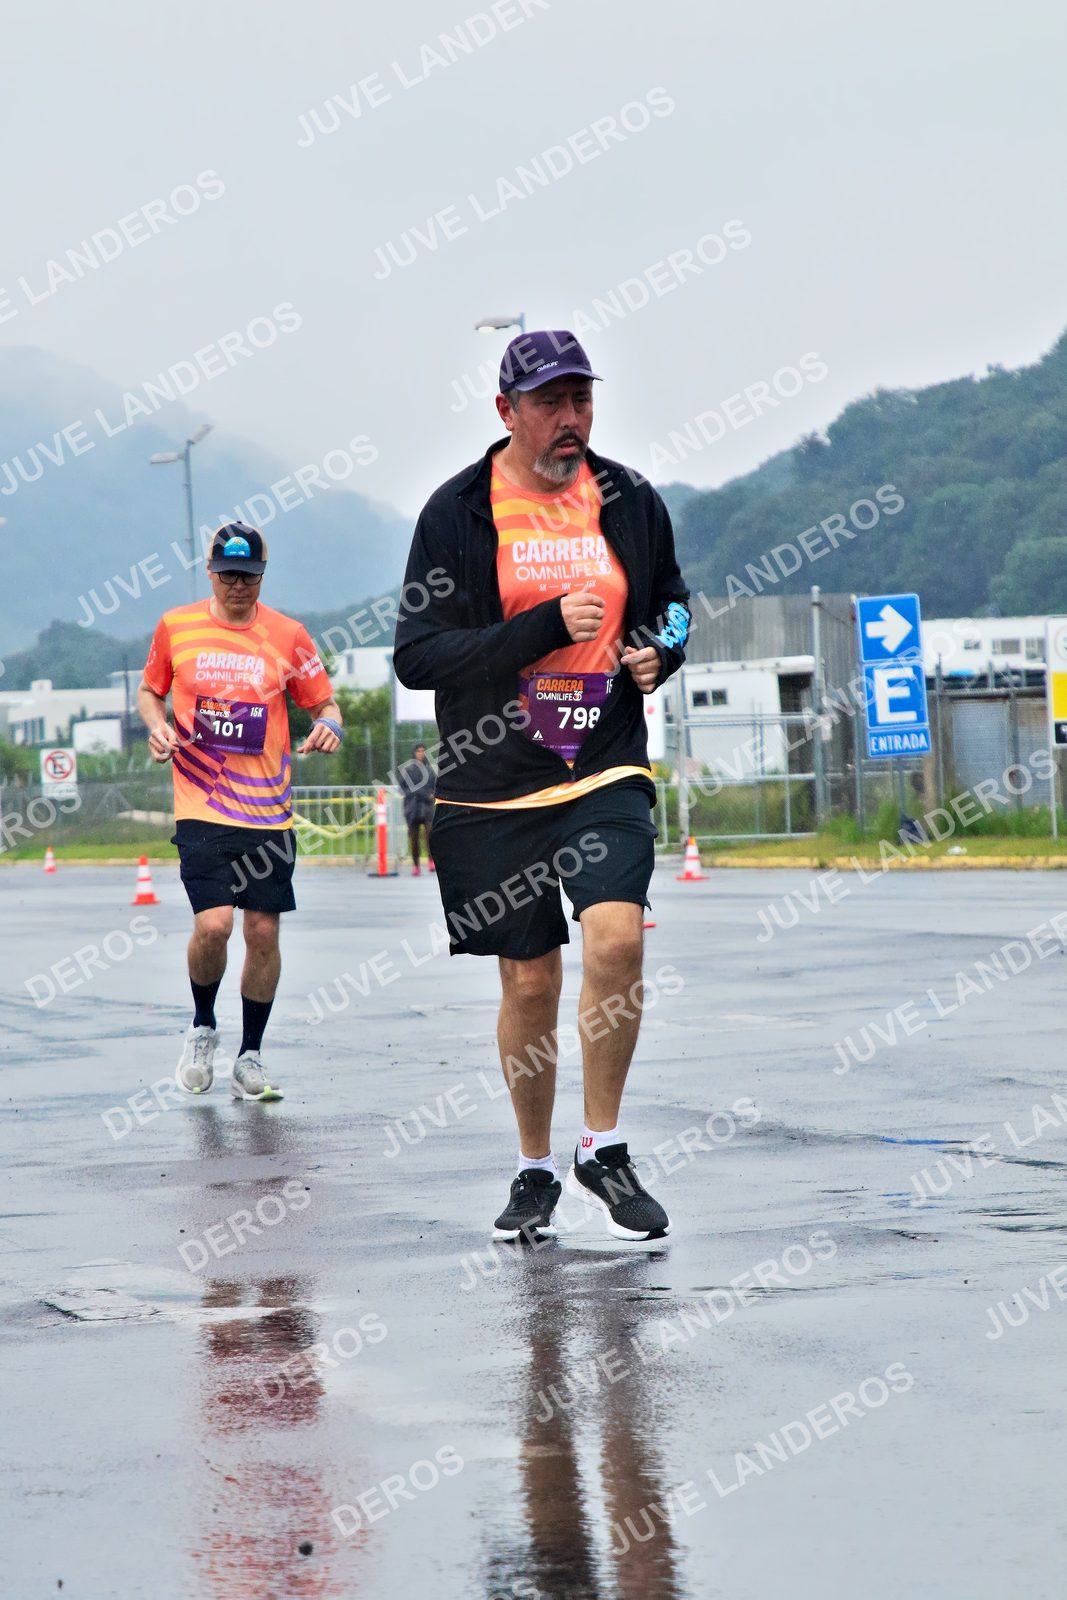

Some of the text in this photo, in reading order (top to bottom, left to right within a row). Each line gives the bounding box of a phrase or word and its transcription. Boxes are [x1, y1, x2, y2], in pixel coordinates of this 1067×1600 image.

[512, 536, 608, 563] CARRERA
[196, 652, 265, 673] CARRERA
[537, 679, 584, 692] CARRERA
[874, 667, 917, 724] E
[200, 700, 232, 711] CARRERA
[250, 707, 264, 717] 15K
[558, 707, 600, 729] 798
[212, 720, 244, 738] 101
[871, 733, 928, 752] ENTRADA
